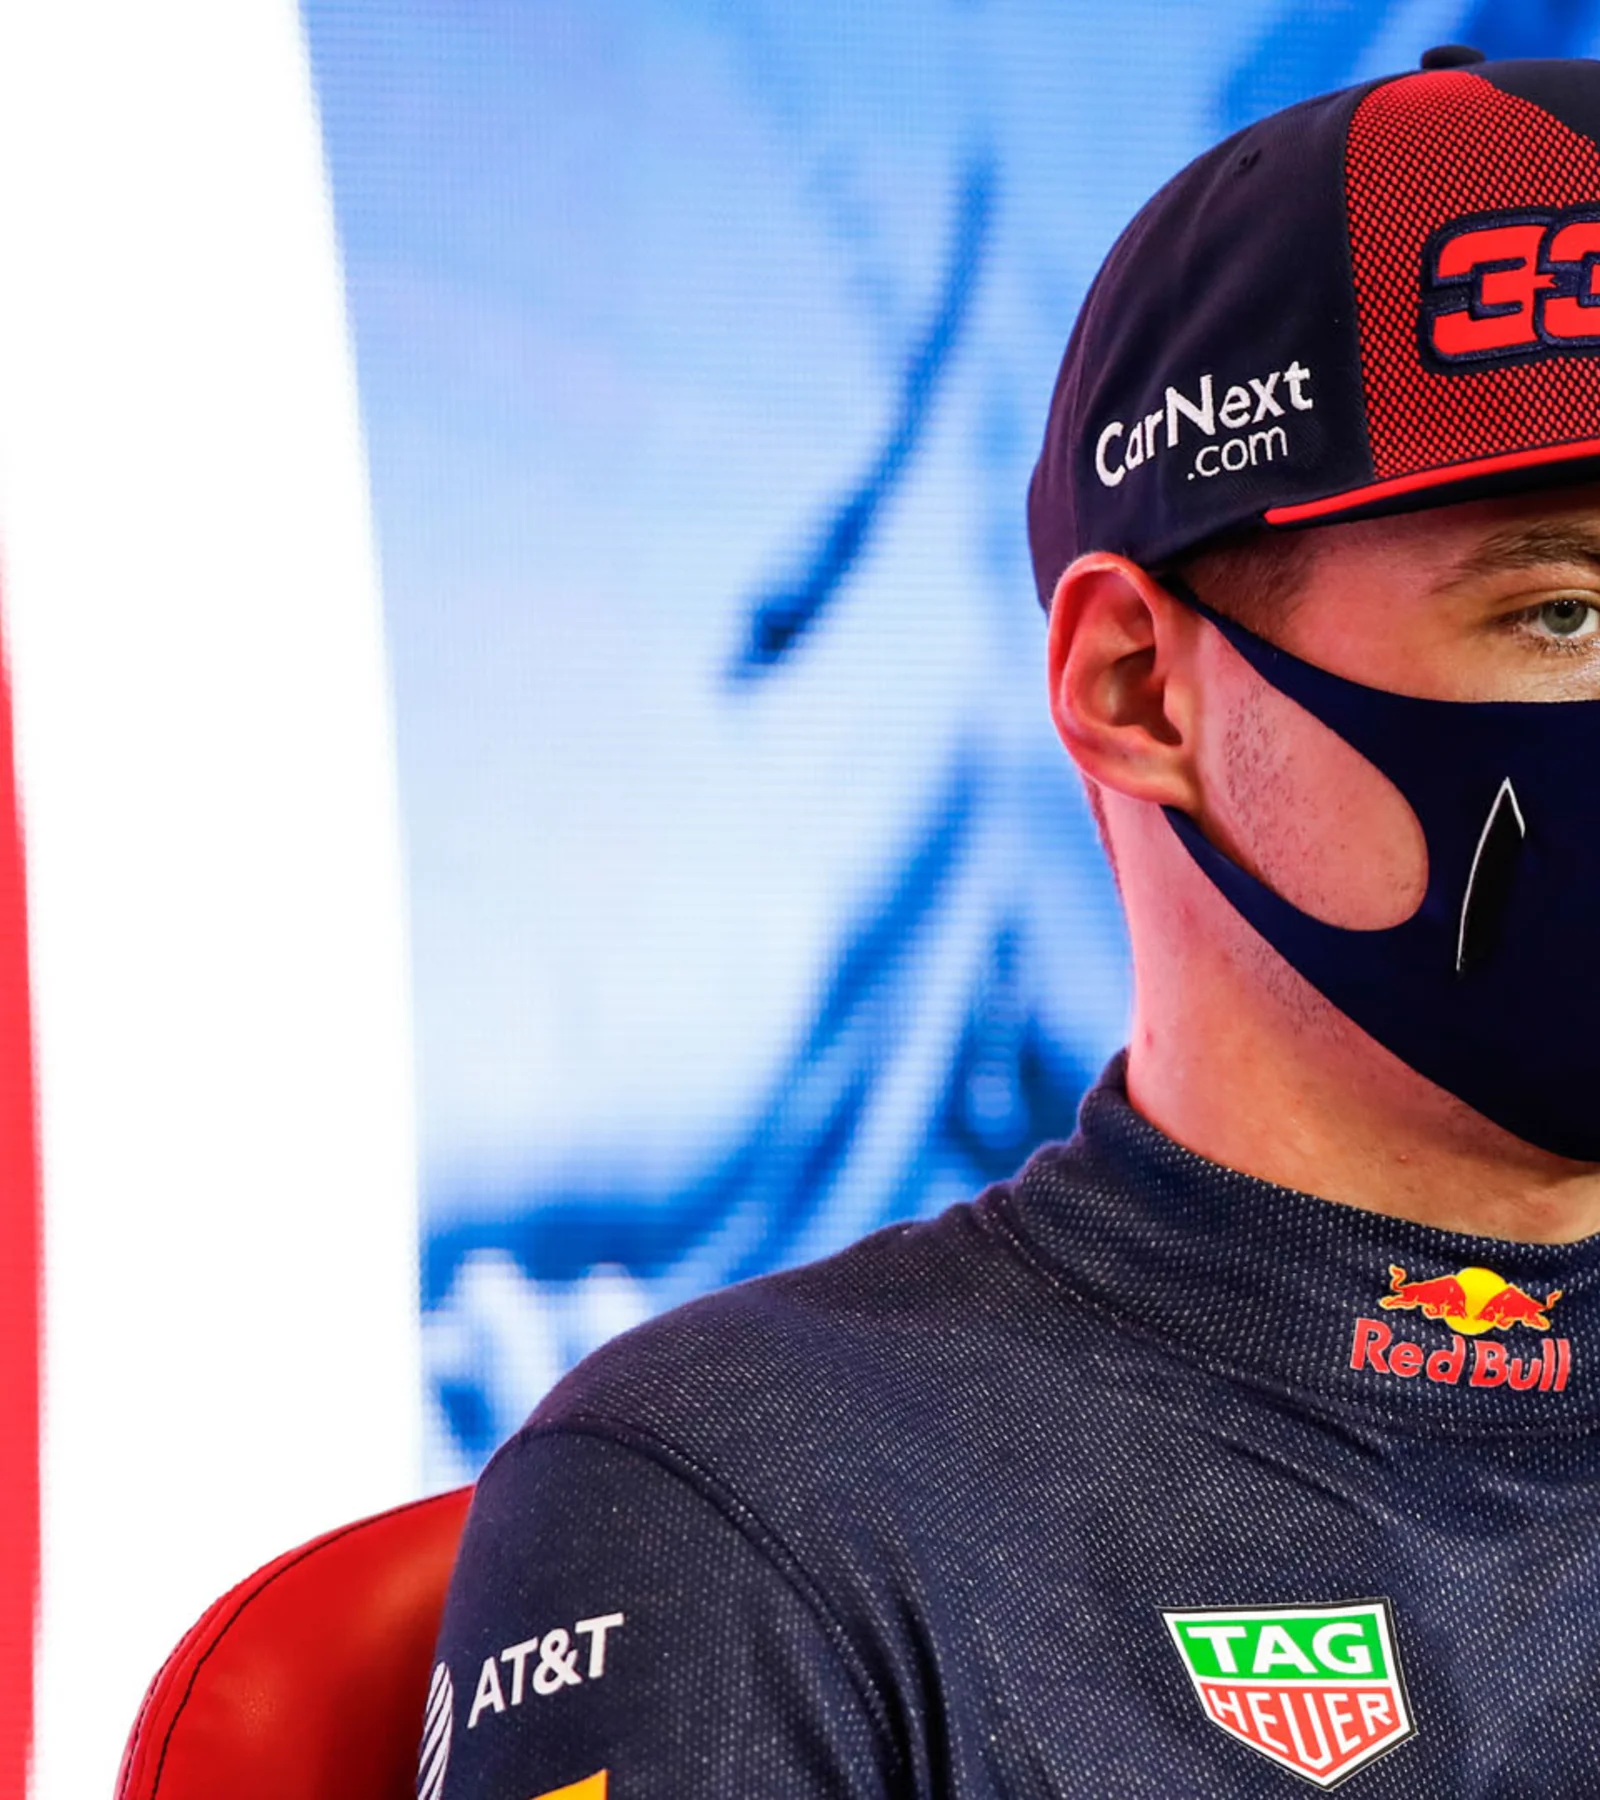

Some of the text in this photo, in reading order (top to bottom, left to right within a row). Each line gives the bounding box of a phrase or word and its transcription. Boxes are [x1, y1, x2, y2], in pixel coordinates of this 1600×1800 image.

[1095, 360, 1314, 488] CarNext
[1187, 426, 1289, 481] .com
[466, 1612, 625, 1730] AT&T
[1186, 1622, 1374, 1675] TAG
[1206, 1687, 1394, 1771] HEUER
